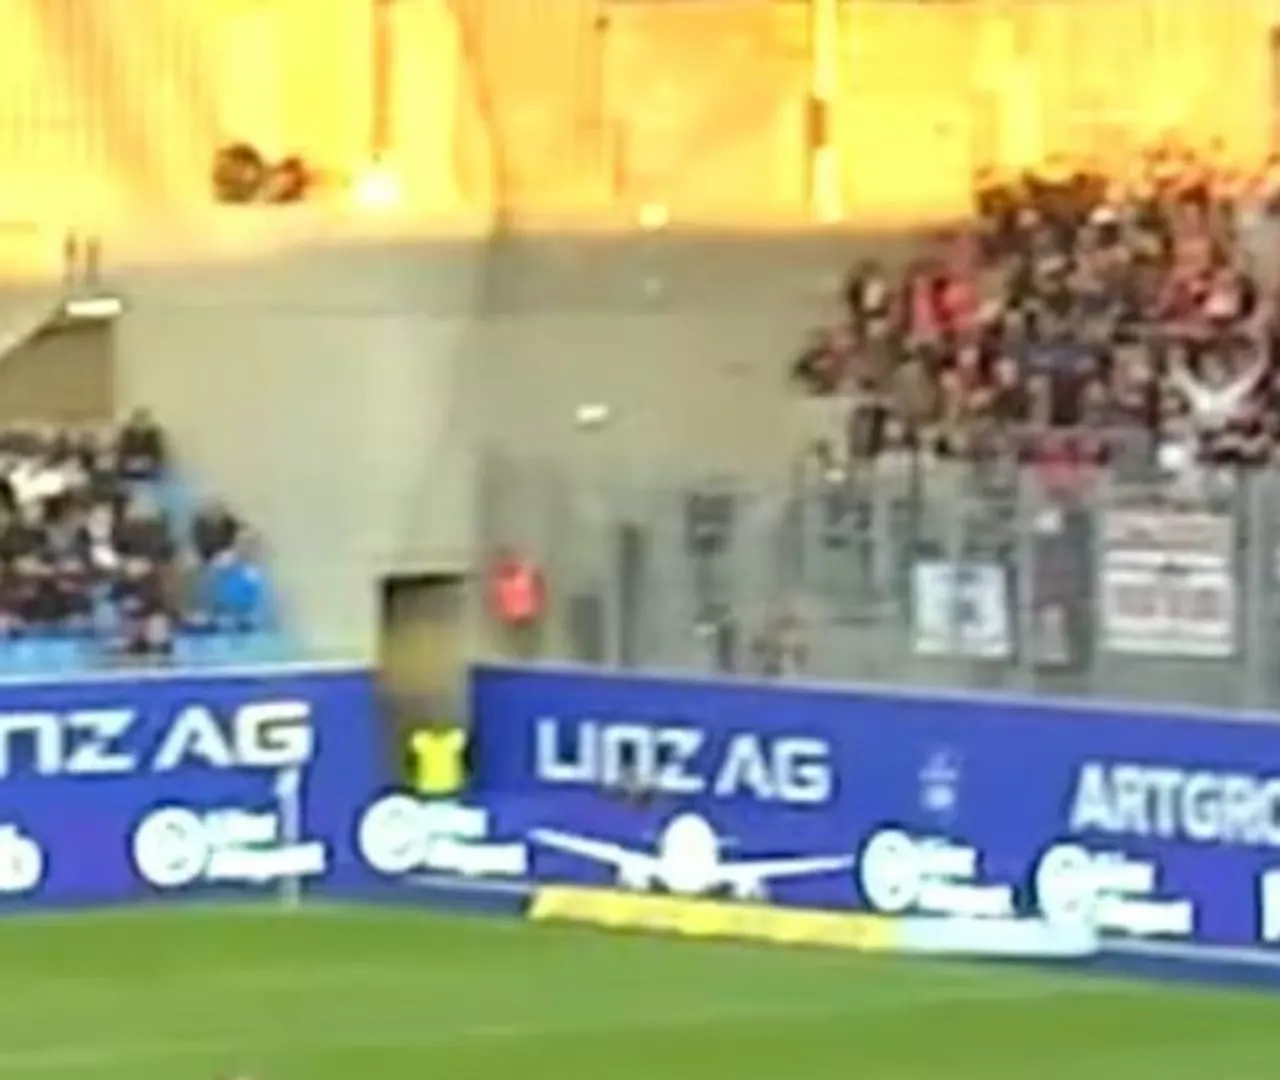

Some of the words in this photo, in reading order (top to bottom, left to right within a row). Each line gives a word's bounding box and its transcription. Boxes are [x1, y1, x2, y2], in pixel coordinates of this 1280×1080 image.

[152, 700, 313, 774] AG
[535, 717, 706, 794] LINZ
[714, 733, 832, 801] AG
